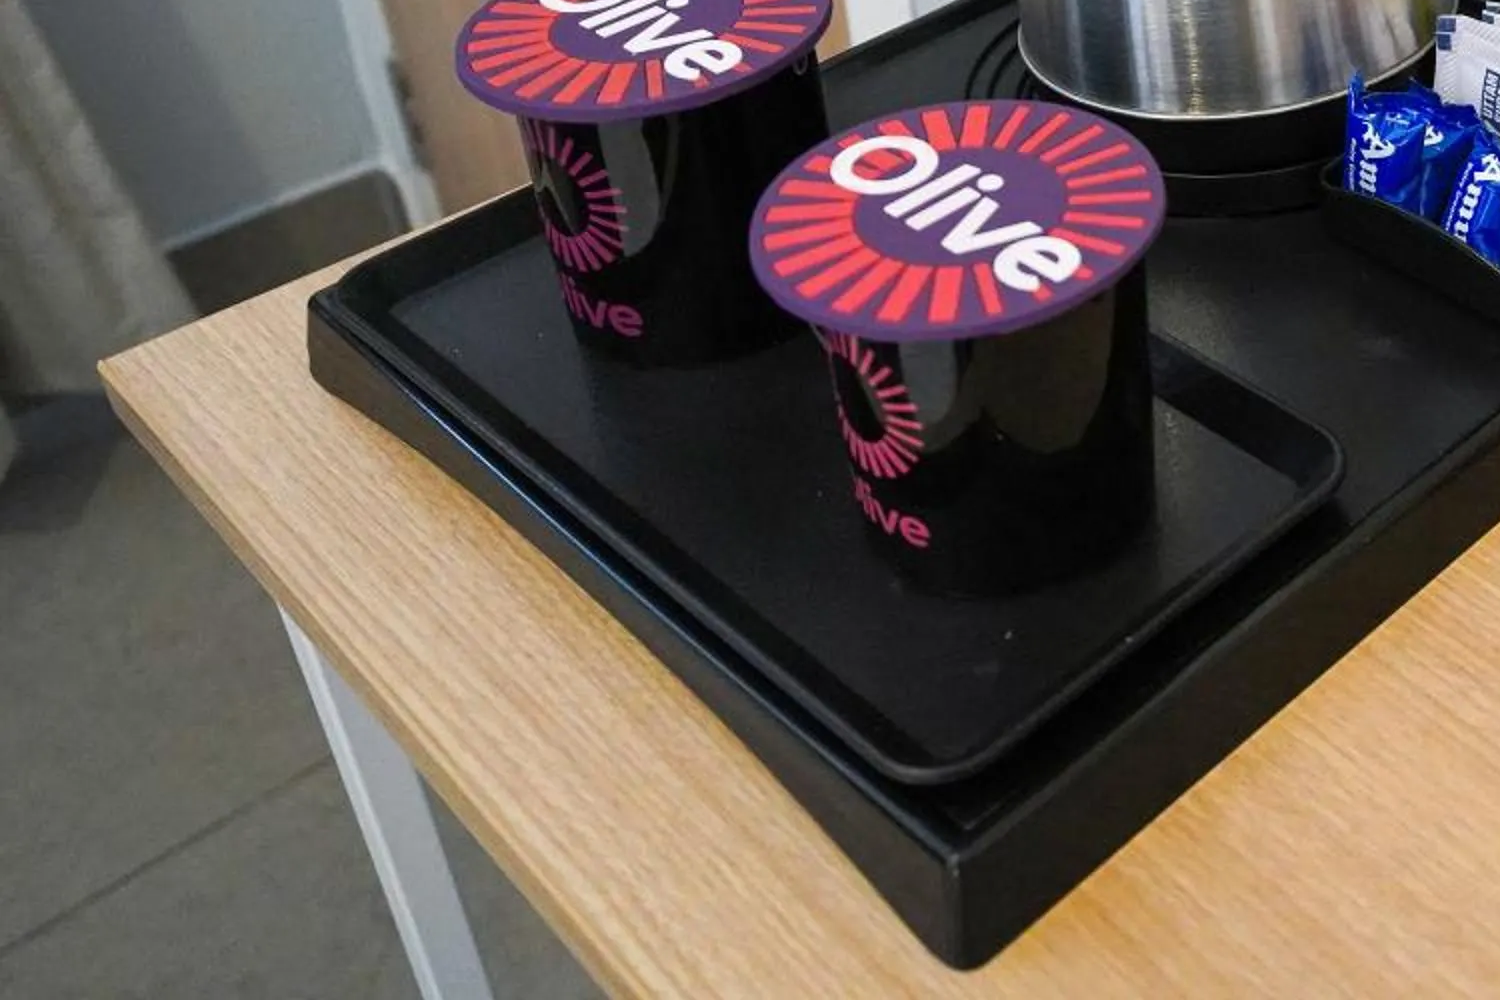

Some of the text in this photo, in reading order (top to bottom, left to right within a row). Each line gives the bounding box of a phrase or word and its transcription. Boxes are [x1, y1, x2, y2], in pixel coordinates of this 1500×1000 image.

[1483, 70, 1498, 120] UTTAM
[1359, 112, 1397, 195] Am
[829, 135, 1084, 292] Olive
[560, 272, 644, 337] live
[852, 476, 932, 549] live
